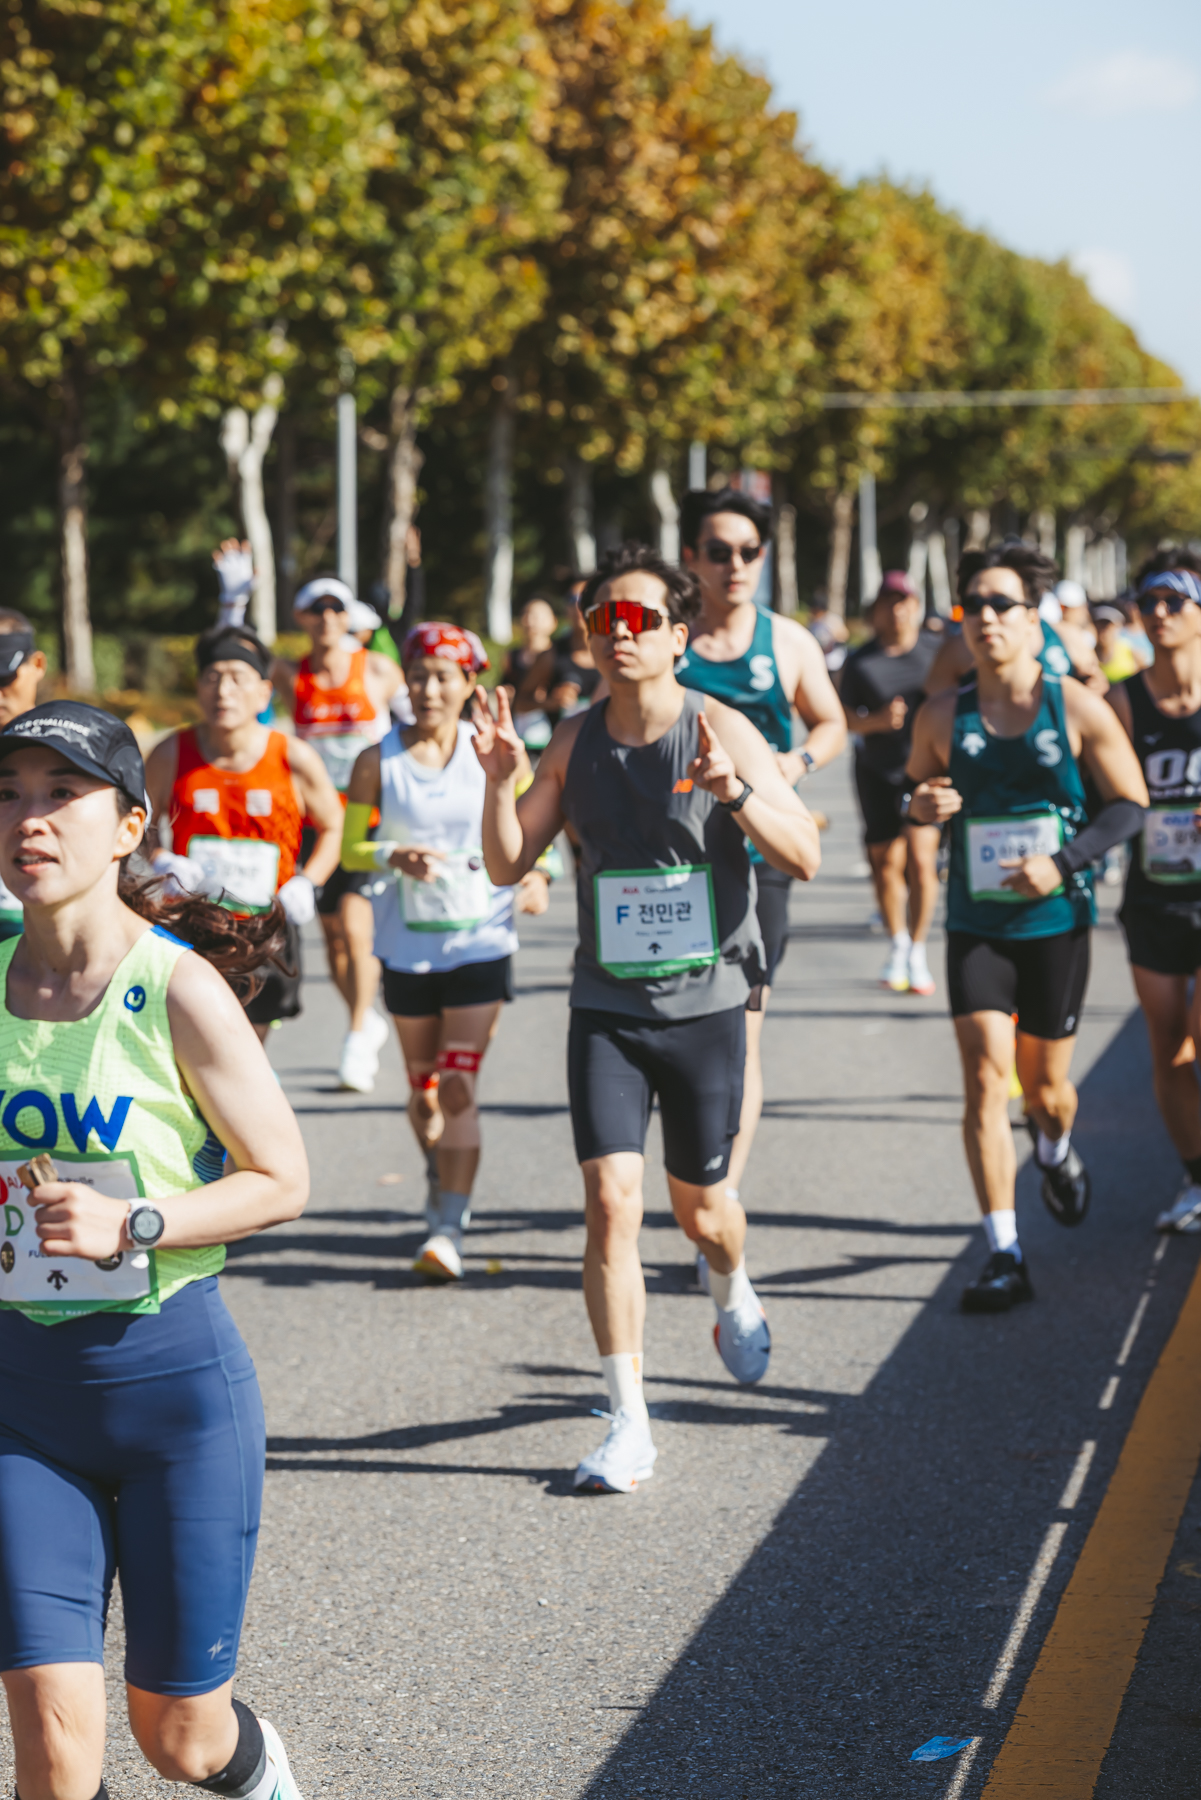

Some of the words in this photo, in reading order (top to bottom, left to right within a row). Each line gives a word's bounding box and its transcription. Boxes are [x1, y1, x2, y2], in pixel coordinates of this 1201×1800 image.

[751, 655, 774, 690] S
[1034, 729, 1062, 766] S
[616, 905, 630, 925] F
[638, 901, 691, 924] 전민관
[0, 1089, 134, 1153] OW
[5, 1205, 24, 1236] D
